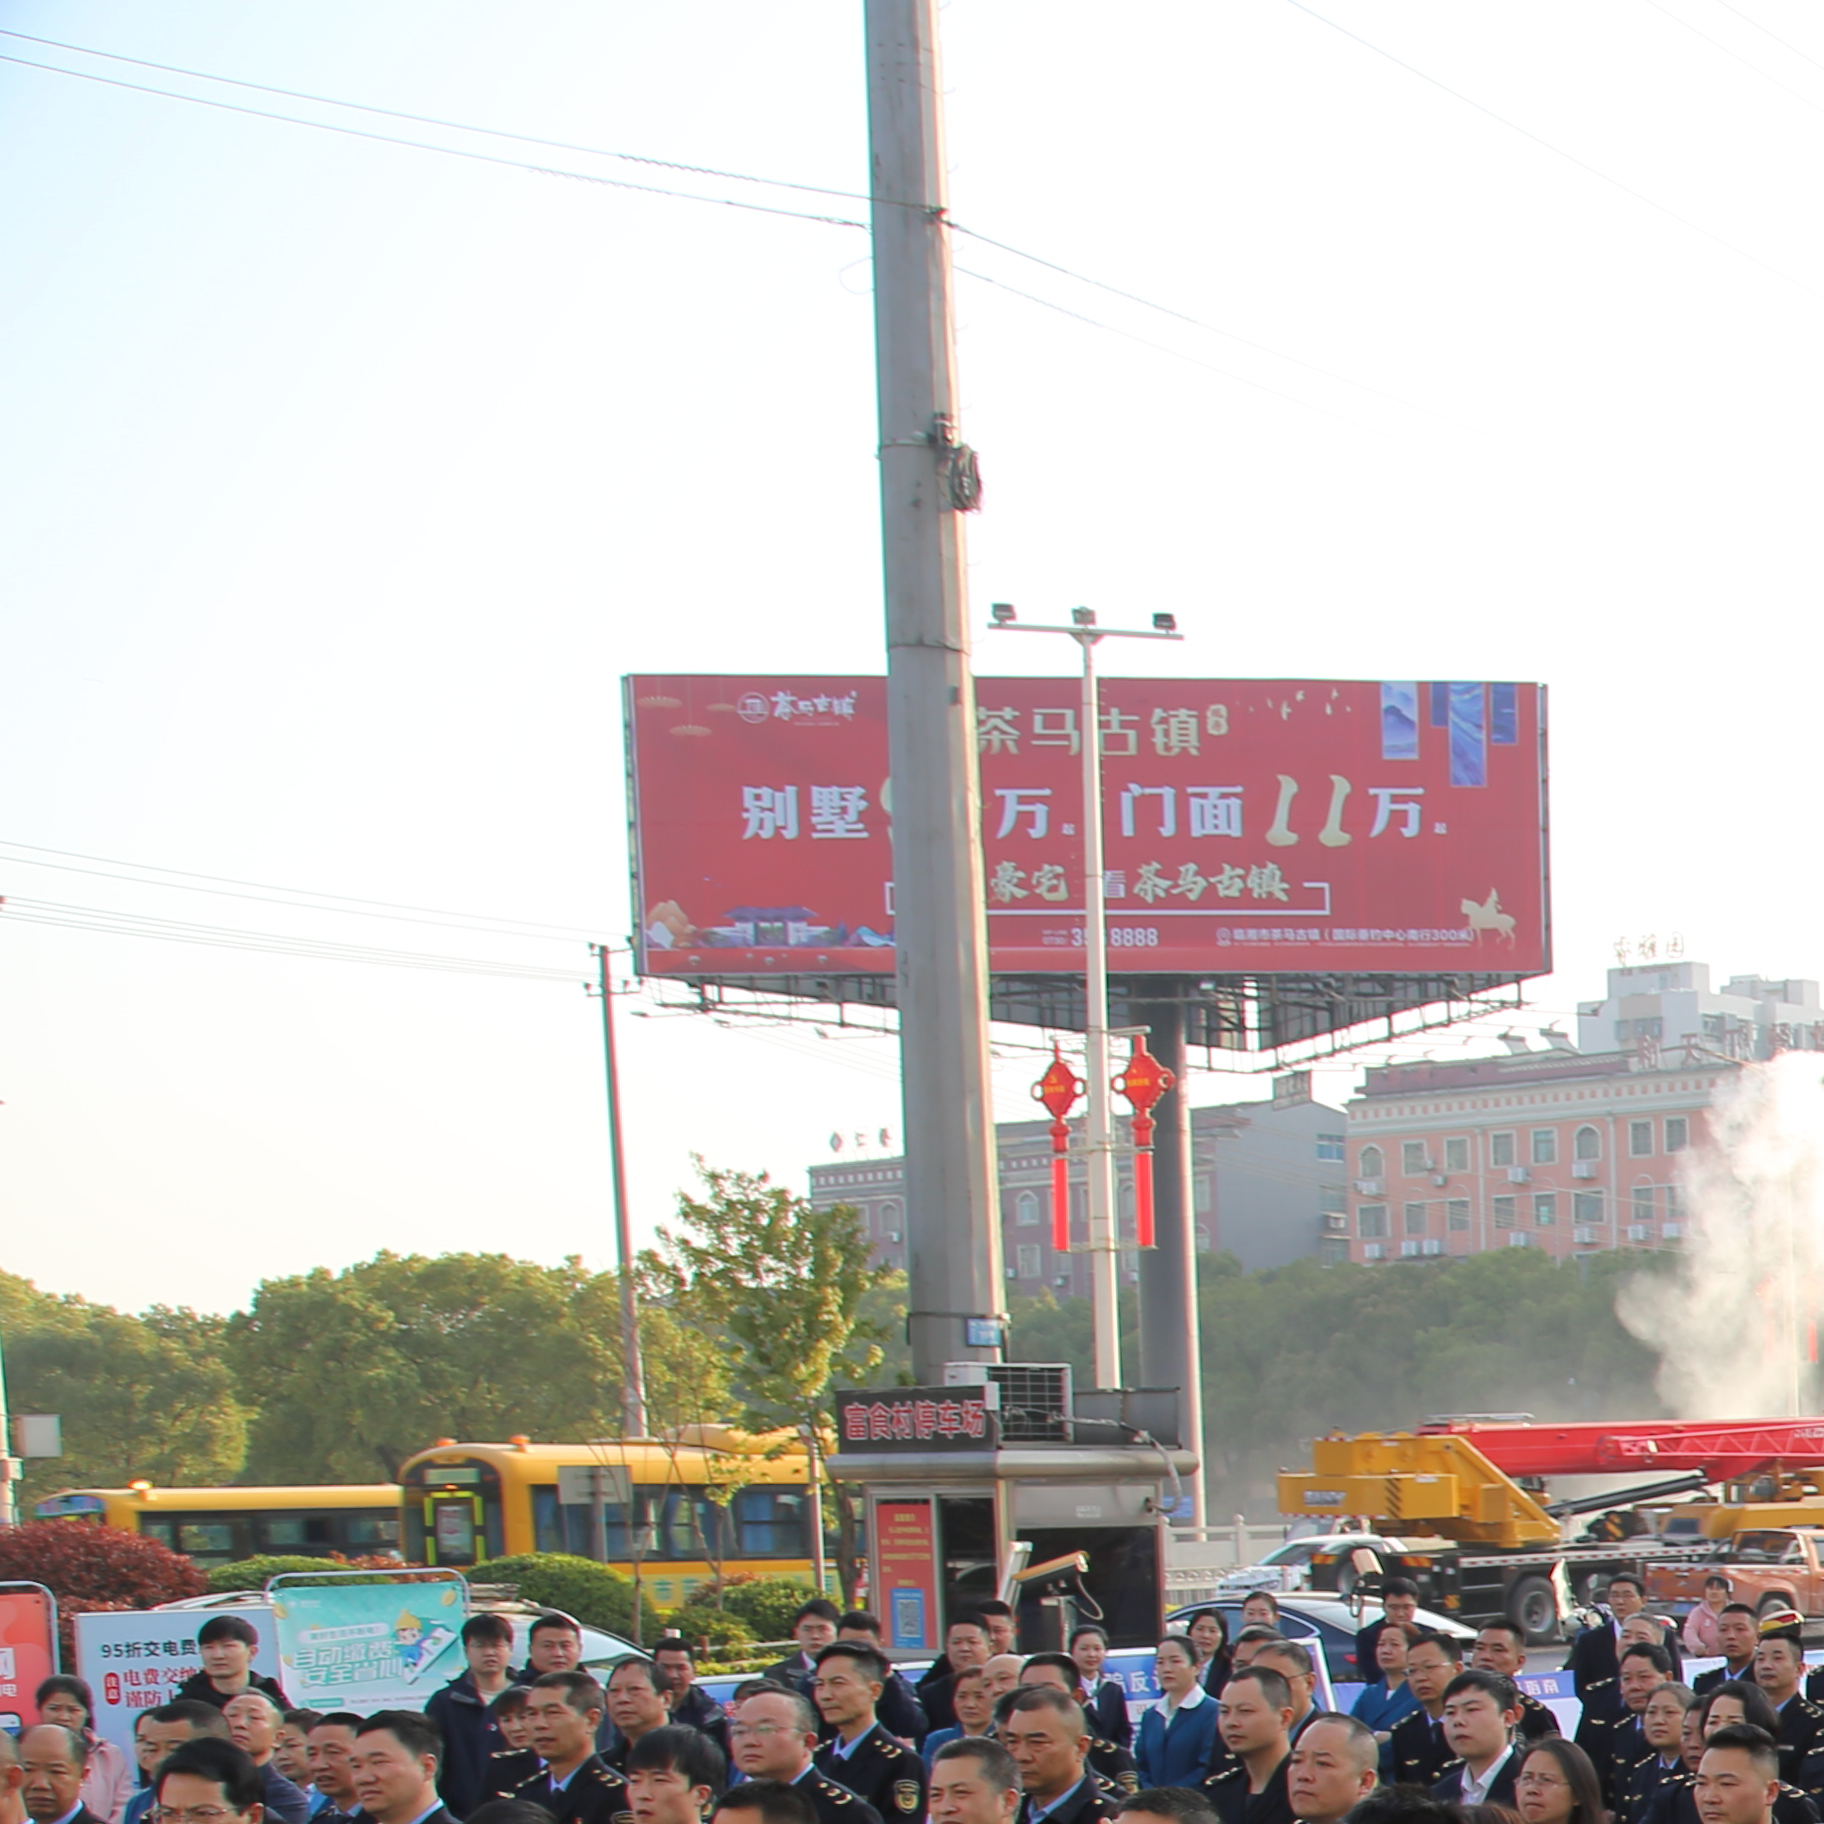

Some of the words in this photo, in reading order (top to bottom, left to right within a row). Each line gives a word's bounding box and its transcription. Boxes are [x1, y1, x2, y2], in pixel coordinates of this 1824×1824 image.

[977, 705, 1201, 757] 茶马古镇
[1071, 926, 1159, 948] 38888
[844, 1400, 985, 1441] 富食村停车场
[101, 1639, 199, 1659] 95折交电费
